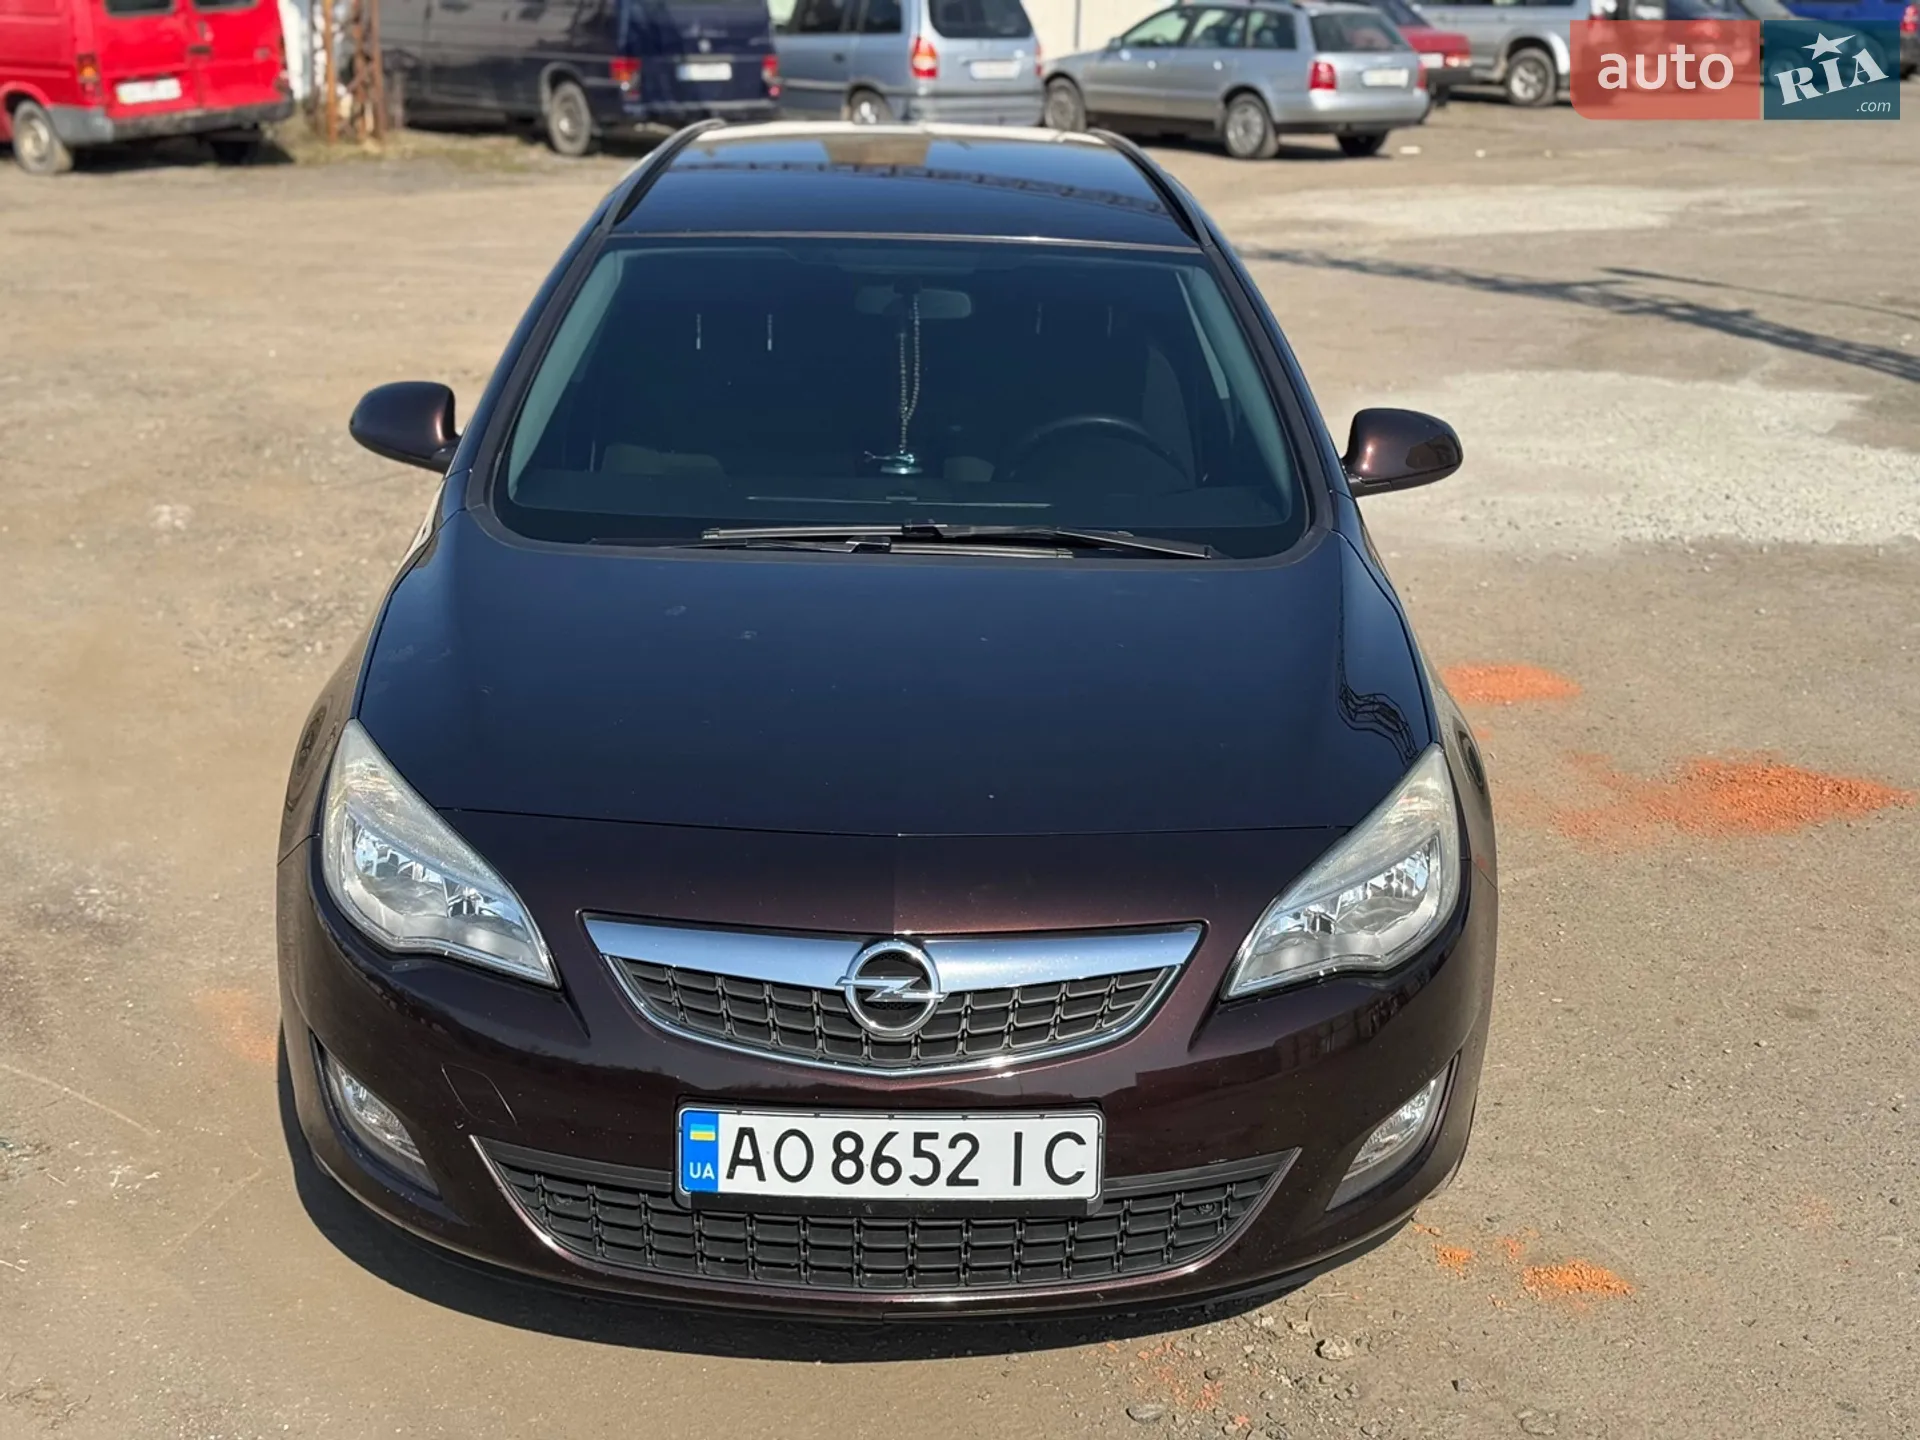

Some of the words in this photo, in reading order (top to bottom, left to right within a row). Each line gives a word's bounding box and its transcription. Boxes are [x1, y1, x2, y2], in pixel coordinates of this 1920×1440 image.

[689, 1162, 715, 1180] UA
[726, 1127, 814, 1182] AO
[831, 1130, 980, 1187] 8652
[1013, 1131, 1087, 1187] IC
